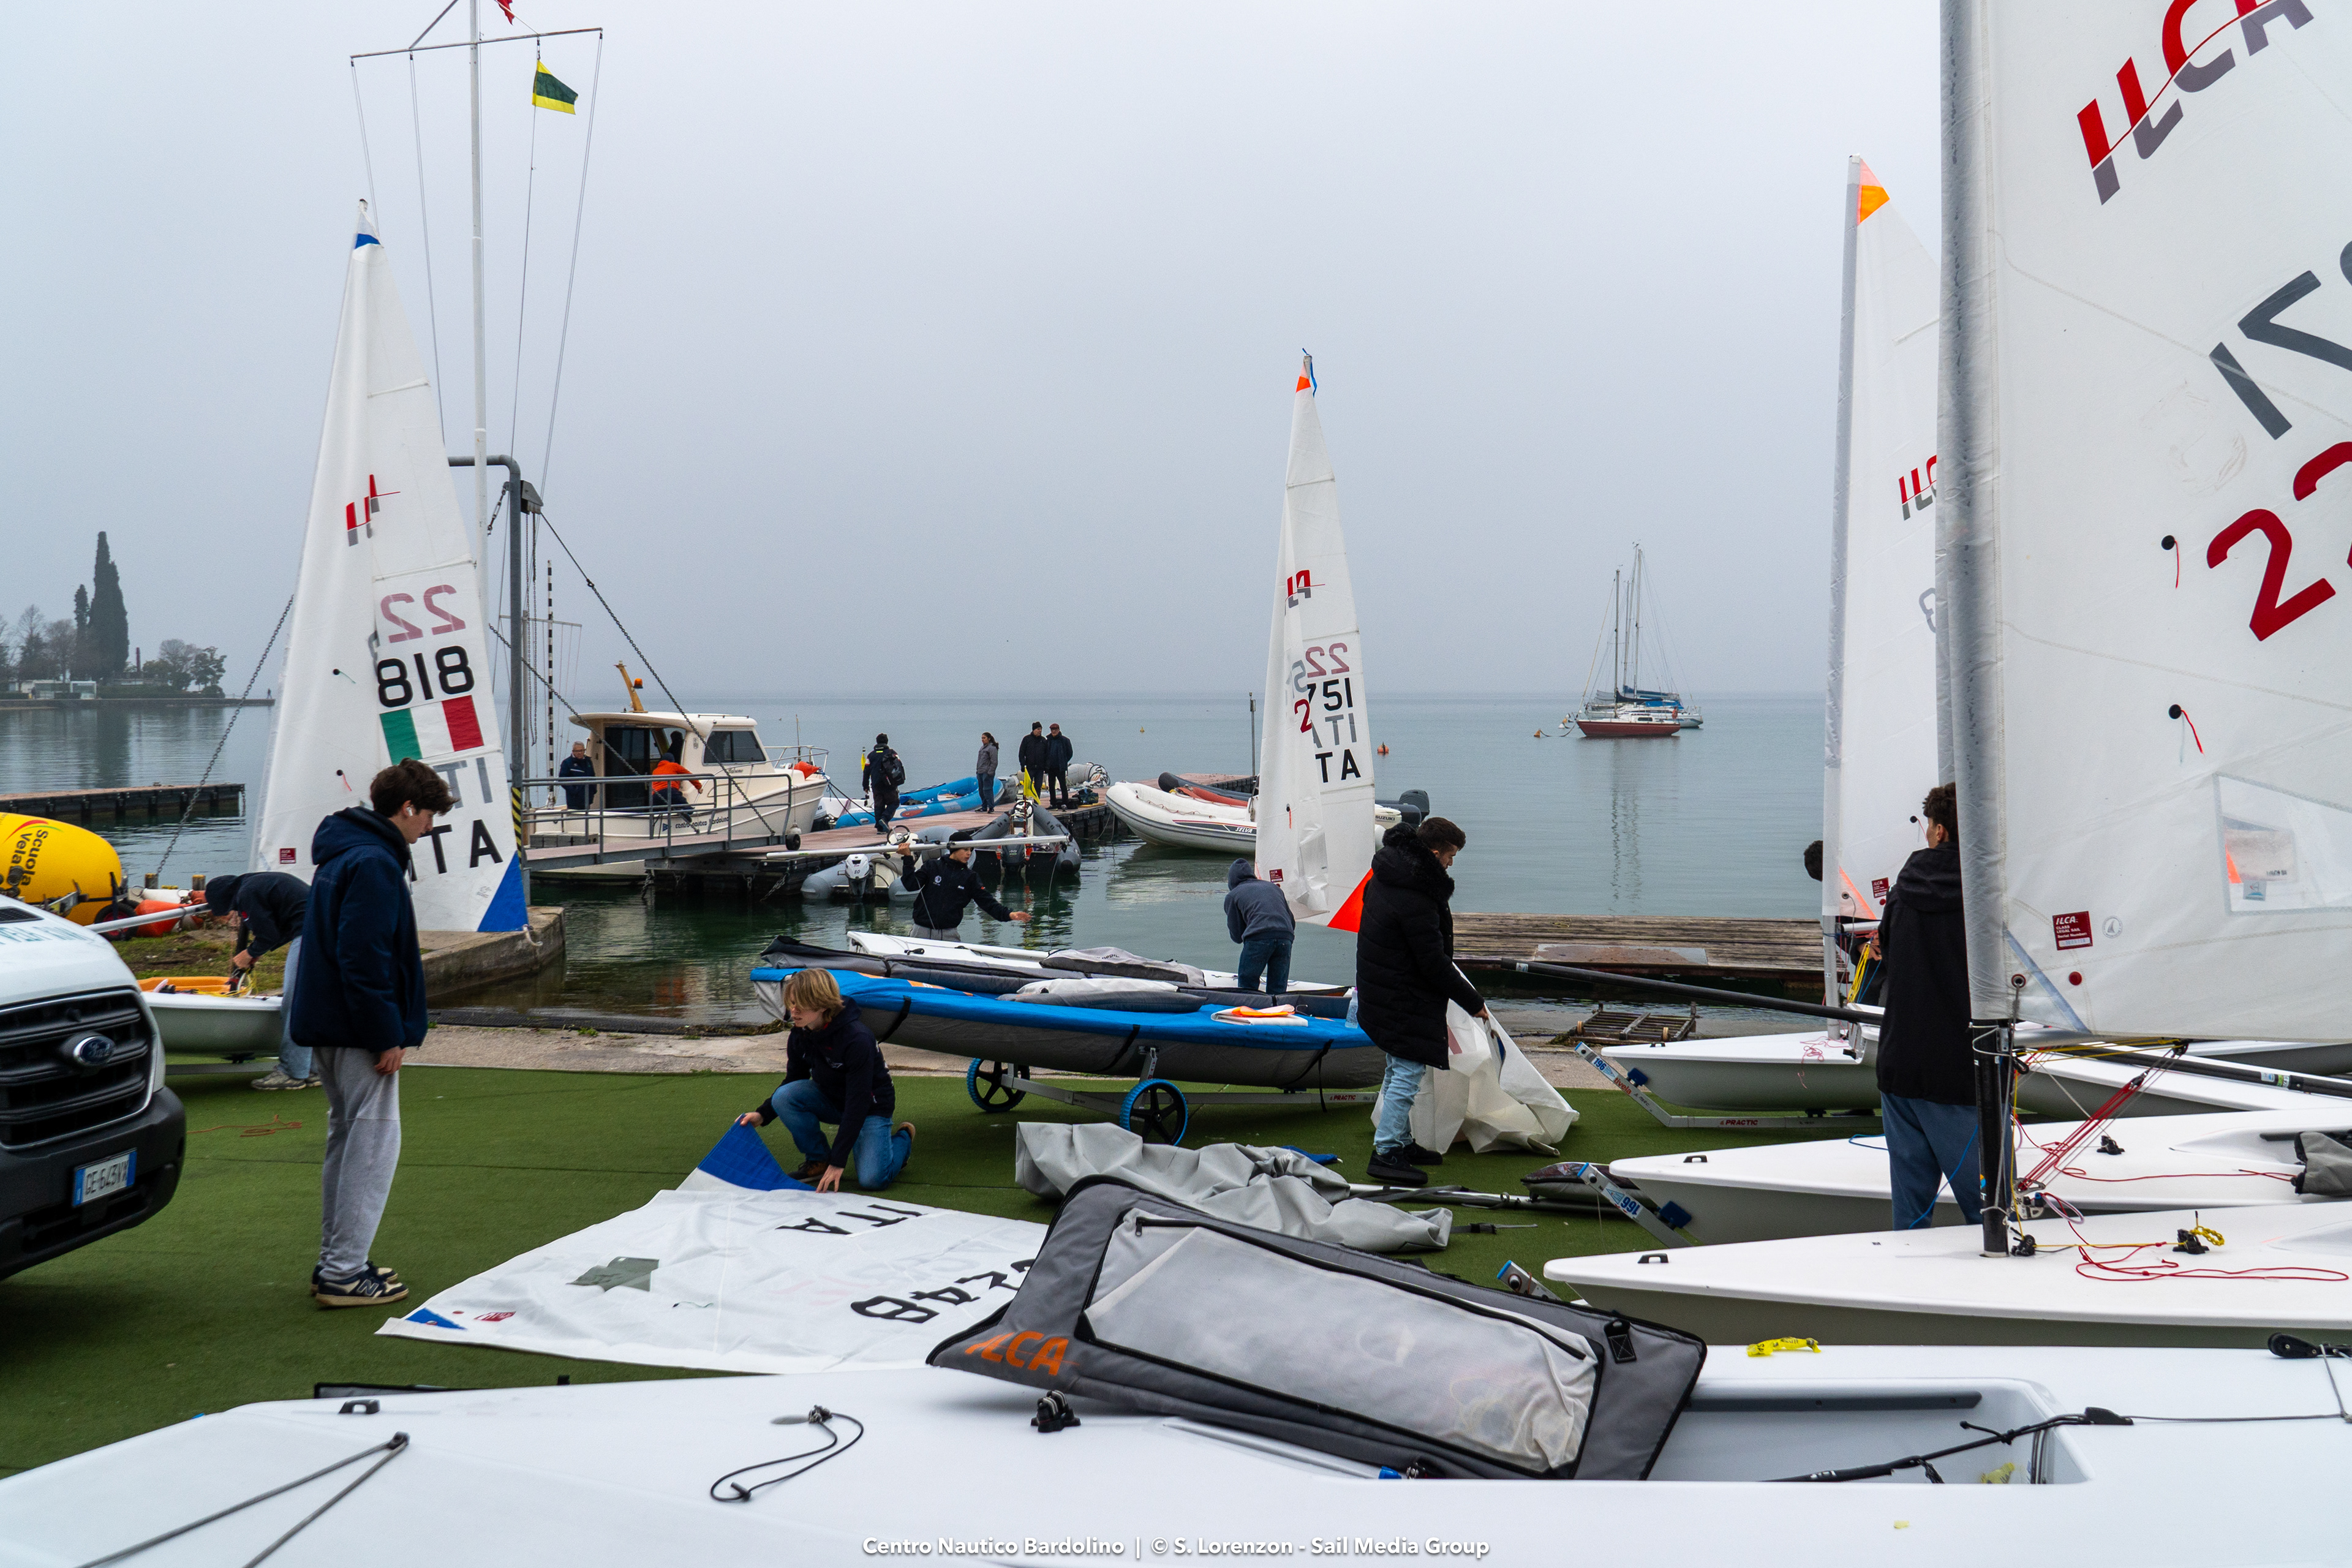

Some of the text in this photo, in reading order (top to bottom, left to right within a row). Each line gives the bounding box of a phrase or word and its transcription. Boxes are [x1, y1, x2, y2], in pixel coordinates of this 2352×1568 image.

[377, 646, 475, 707] 818
[11, 833, 33, 865] Vela
[21, 829, 48, 886] Scuola
[2056, 916, 2076, 925] ILCA
[1593, 1057, 1607, 1071] 196
[1614, 1077, 1632, 1095] tivela
